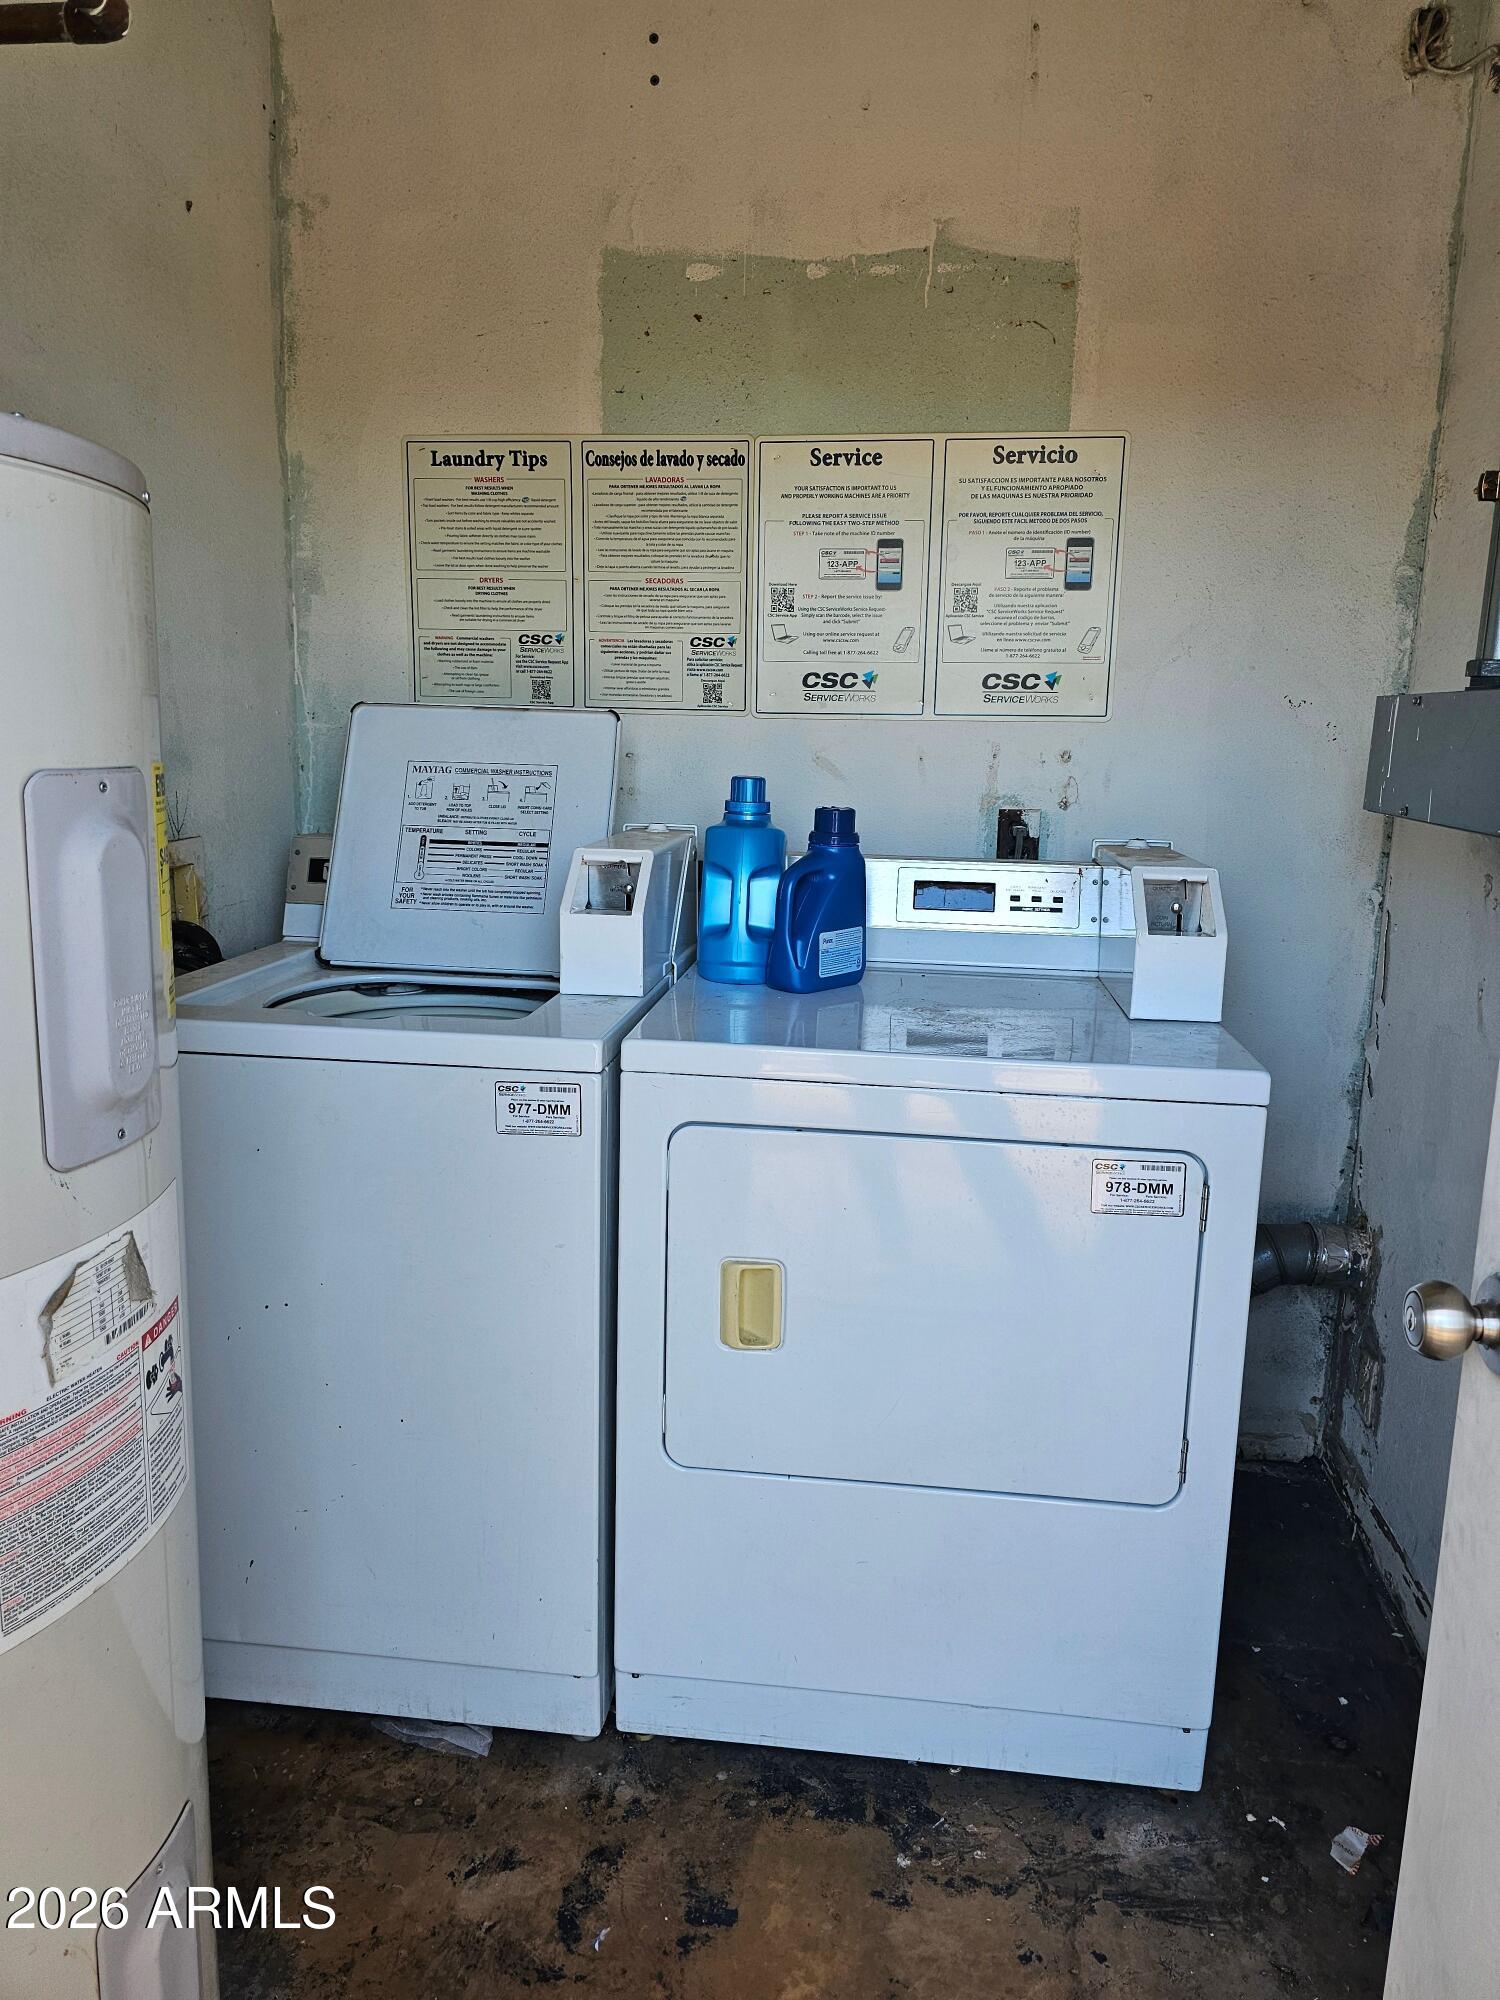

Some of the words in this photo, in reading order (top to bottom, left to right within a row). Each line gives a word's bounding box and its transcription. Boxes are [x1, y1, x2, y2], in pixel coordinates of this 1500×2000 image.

[431, 449, 505, 471] Laundry
[509, 450, 548, 471] Tips
[585, 450, 637, 471] Consejos
[640, 449, 654, 466] de
[656, 449, 694, 466] lavado
[697, 454, 704, 471] y
[707, 449, 745, 466] secado
[810, 448, 883, 466] Service
[993, 445, 1078, 464] Servicio
[519, 634, 552, 645] CSC
[690, 637, 725, 647] CSC
[802, 672, 858, 689] CSC
[982, 673, 1041, 690] CSC
[412, 765, 452, 774] MAYTAG
[508, 1103, 571, 1115] 977-DMM
[1106, 1182, 1173, 1195] 978-DMM
[153, 1302, 177, 1338] DANGER
[116, 1341, 139, 1360] CAUTION
[46, 1386, 70, 1401] ELECTRIC
[71, 1376, 86, 1388] WATER
[86, 1366, 103, 1379] HEATER
